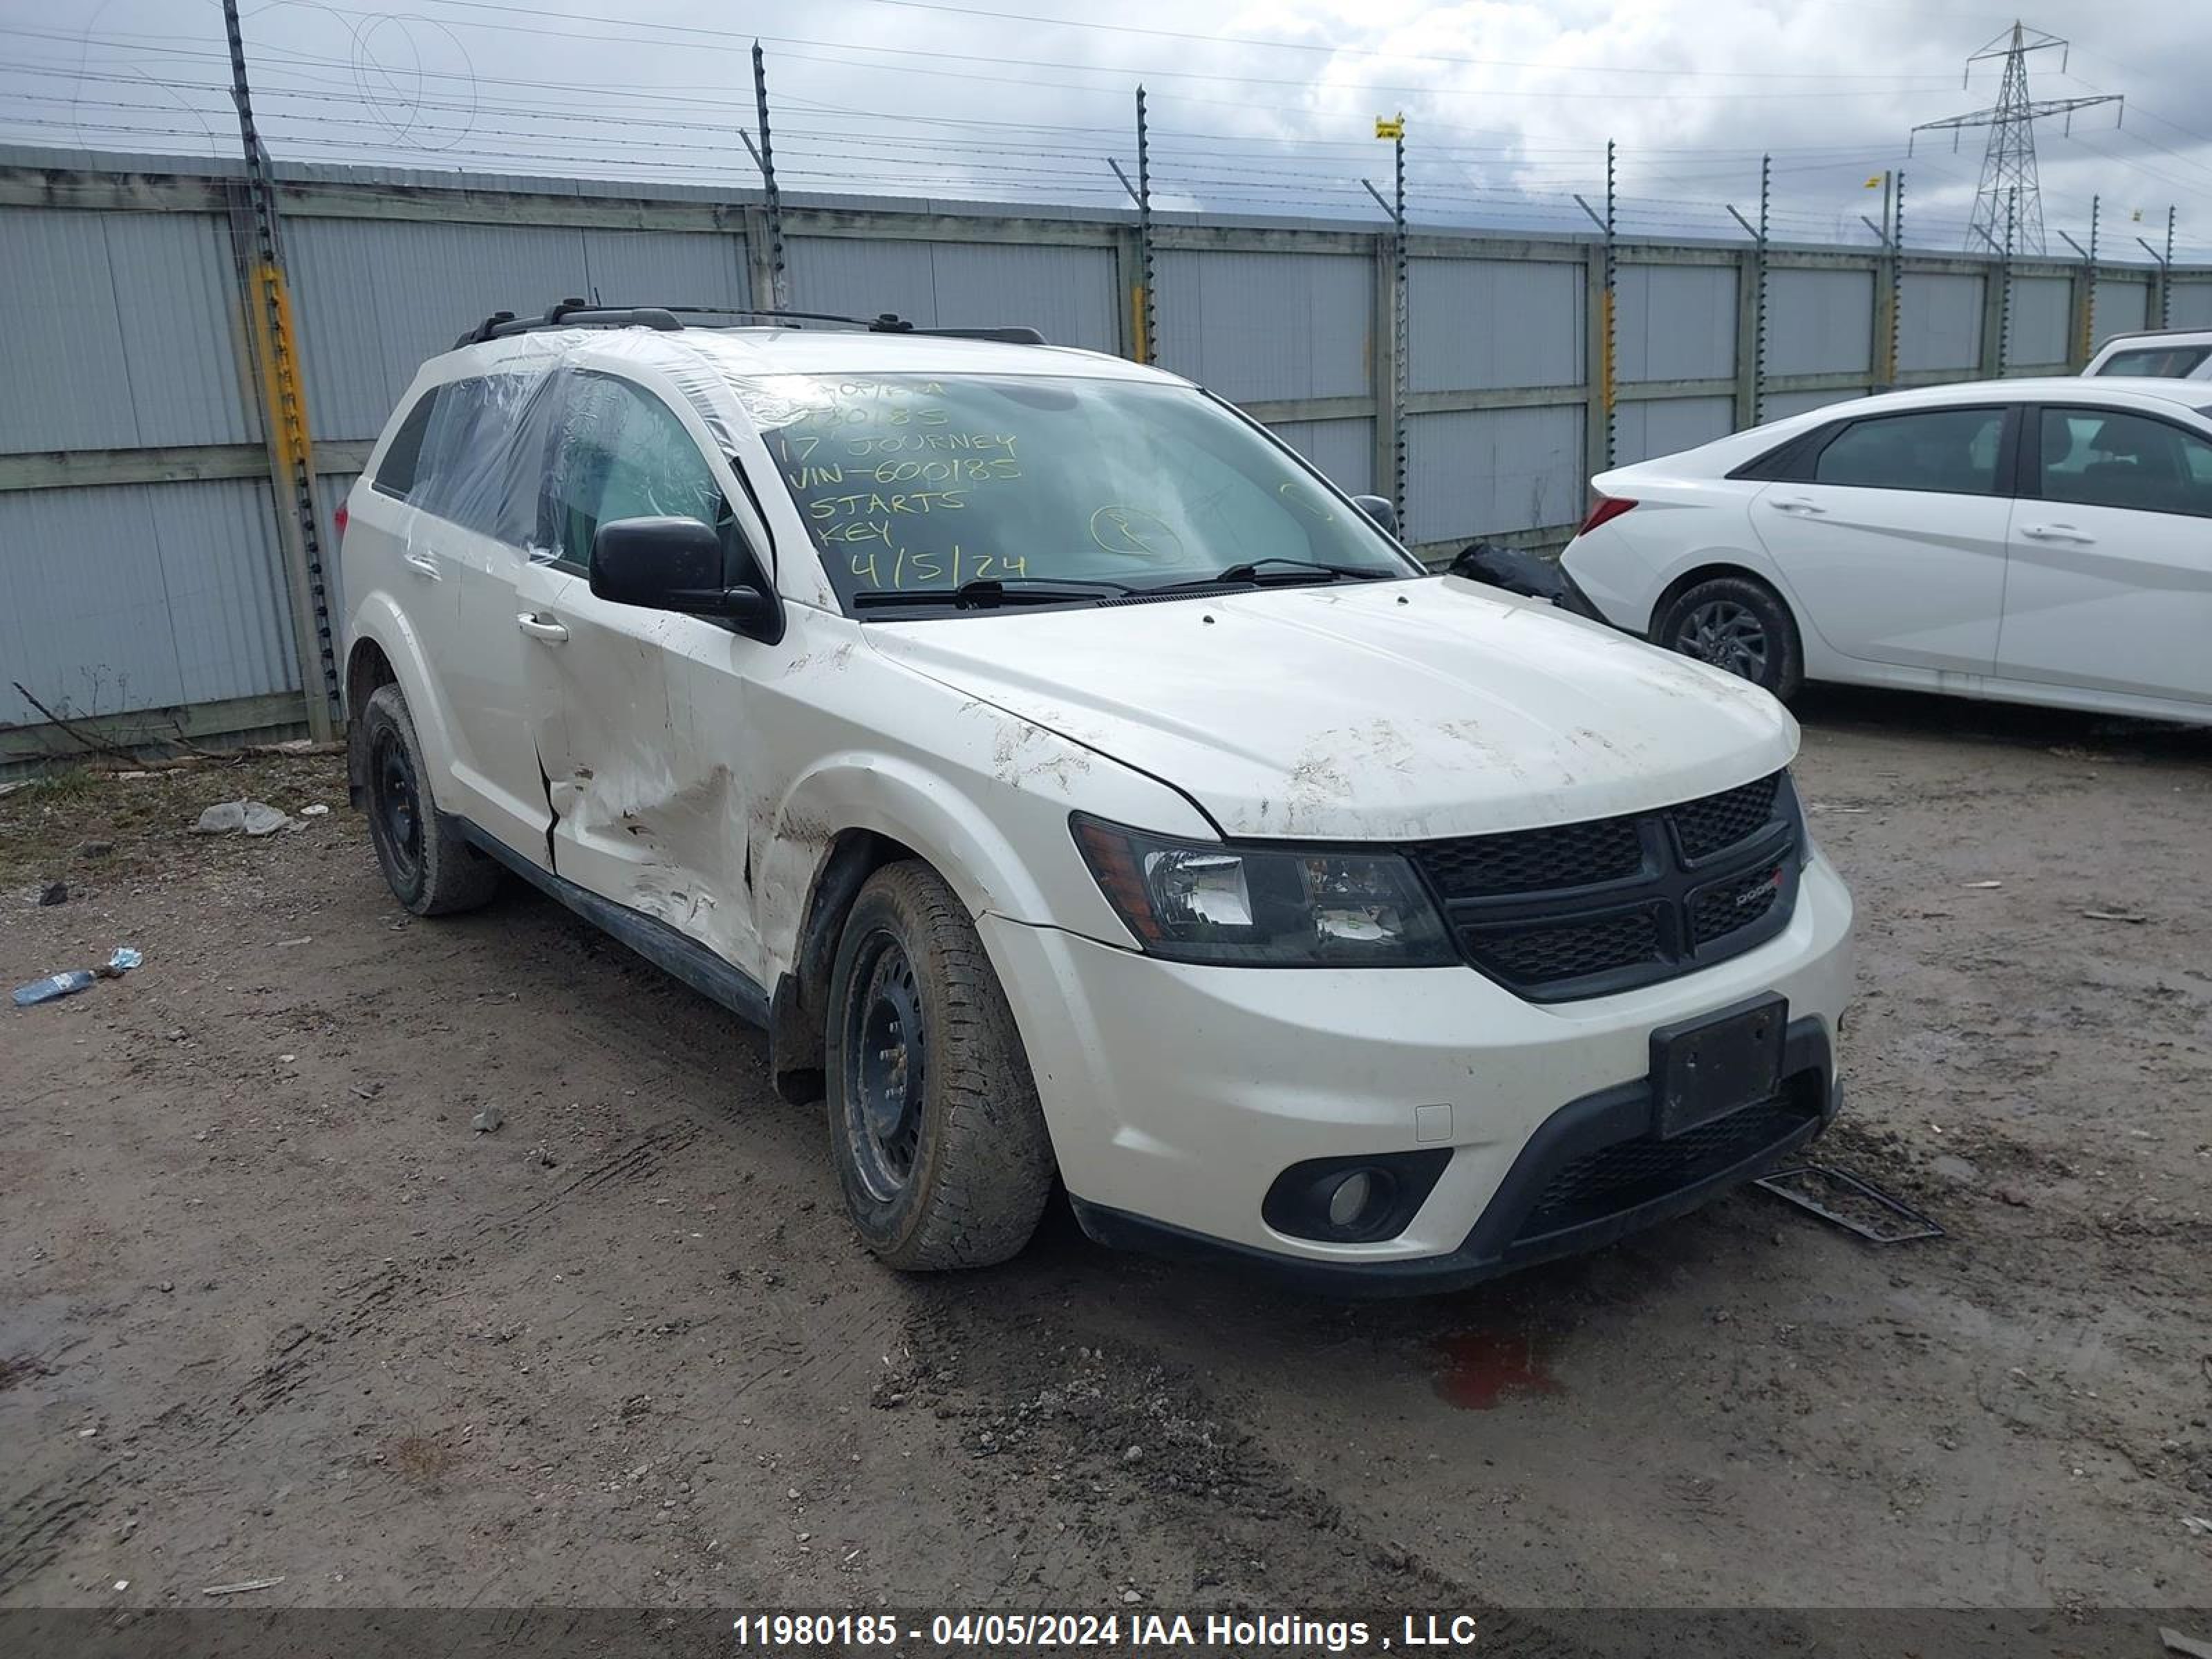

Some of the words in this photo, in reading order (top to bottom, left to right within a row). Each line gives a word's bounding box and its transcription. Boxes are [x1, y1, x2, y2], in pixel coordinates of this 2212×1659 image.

[847, 434, 1018, 458] JOURNEY
[809, 490, 969, 519] STARTS
[816, 520, 893, 547] KEY
[852, 545, 1027, 589] 4/5/24
